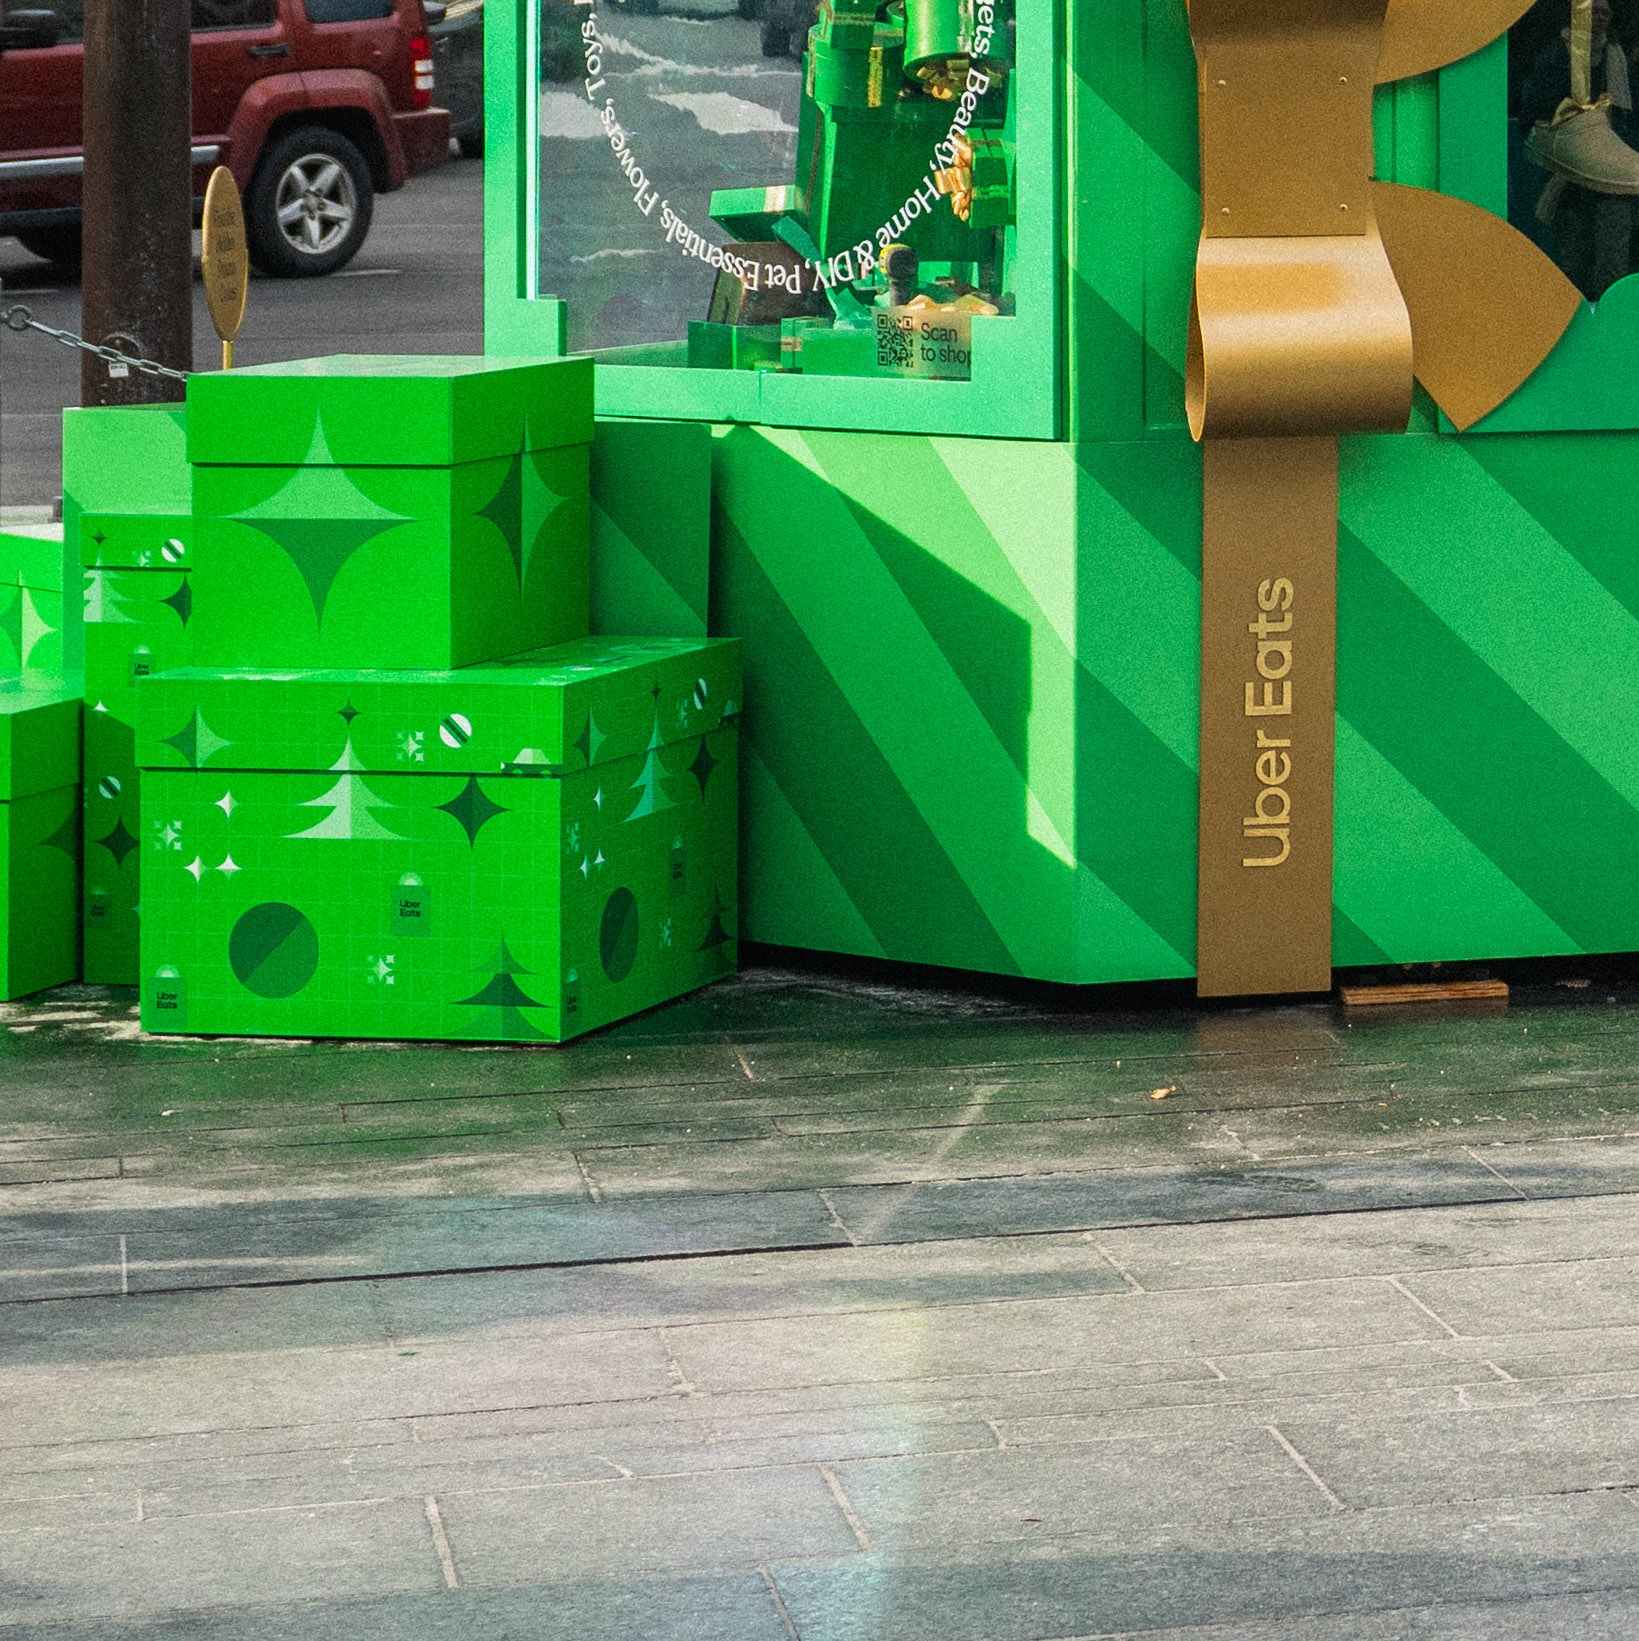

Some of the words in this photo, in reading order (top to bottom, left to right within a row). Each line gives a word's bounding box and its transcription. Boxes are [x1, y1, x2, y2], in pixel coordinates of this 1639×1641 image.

[580, 12, 605, 101] Toys,
[929, 66, 991, 175] Beauty,
[600, 97, 660, 217] Flowers,
[876, 175, 942, 250] Home
[659, 198, 759, 292] Essentials,
[852, 239, 876, 271] &
[764, 264, 802, 295] Pet
[804, 248, 853, 292] DIY,
[921, 322, 958, 342] Scan
[920, 344, 937, 361] to
[1244, 577, 1294, 716] Eats
[1243, 729, 1292, 868] Uber
[400, 900, 421, 908] Uber
[400, 908, 421, 917] Eats
[156, 991, 177, 1000] Uber
[156, 1000, 178, 1009] Eats
